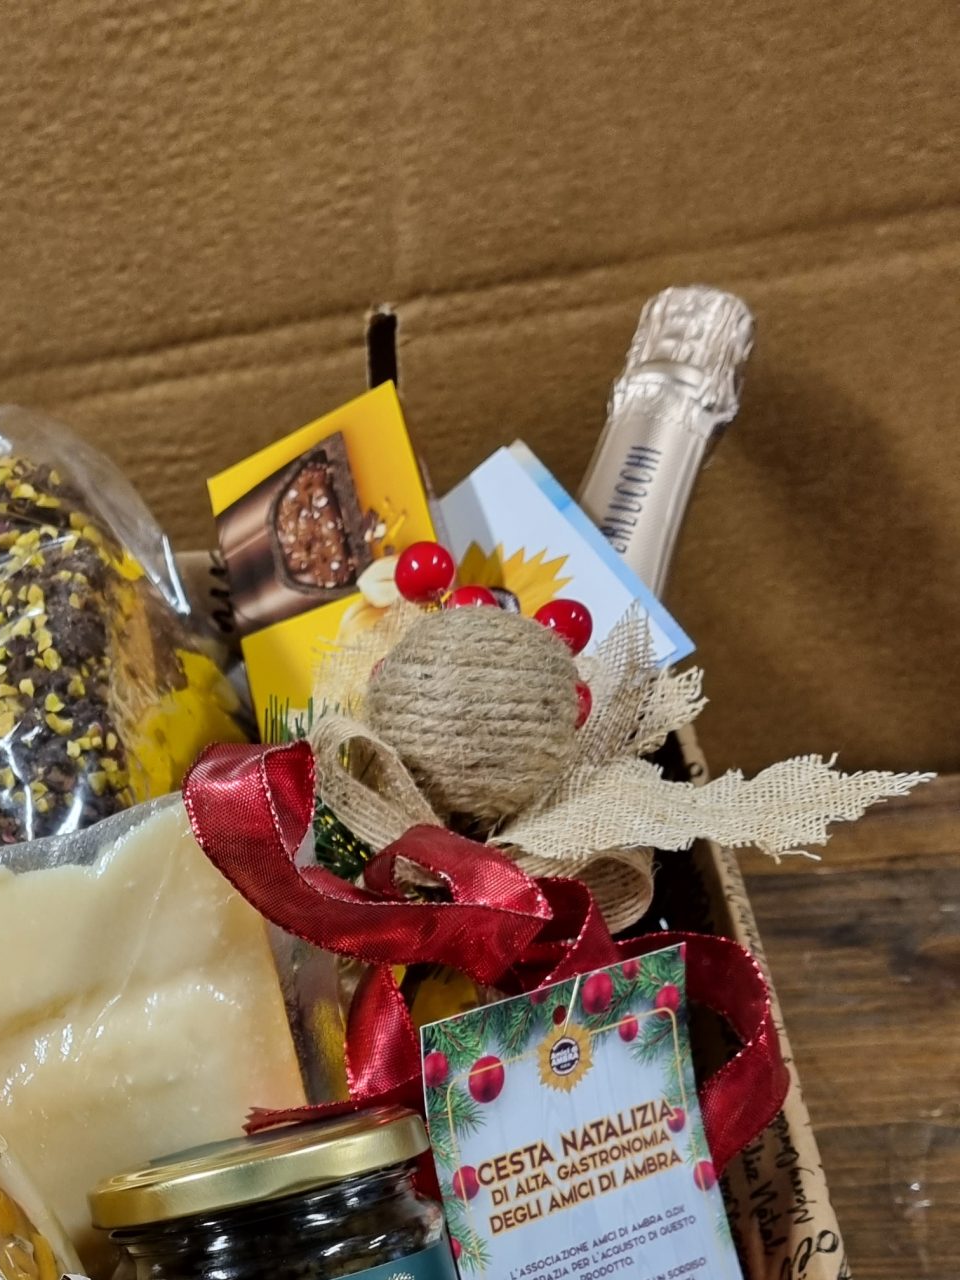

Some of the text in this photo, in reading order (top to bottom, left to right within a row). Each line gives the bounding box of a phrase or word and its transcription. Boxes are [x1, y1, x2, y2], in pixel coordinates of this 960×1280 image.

[474, 1096, 676, 1188] CESTA NATALIZIA
[490, 1127, 671, 1206] DI ALTA GASTRONOMIA
[487, 1146, 683, 1233] DEGLI AMICI DI AMBRA
[507, 1212, 664, 1280] L'ASSOCIAZIONE AMICI DI AMBRA
[569, 1257, 591, 1272] PER
[589, 1234, 648, 1264] L'ACQUISTO
[645, 1229, 659, 1241] DI
[657, 1213, 698, 1236] QUESTO
